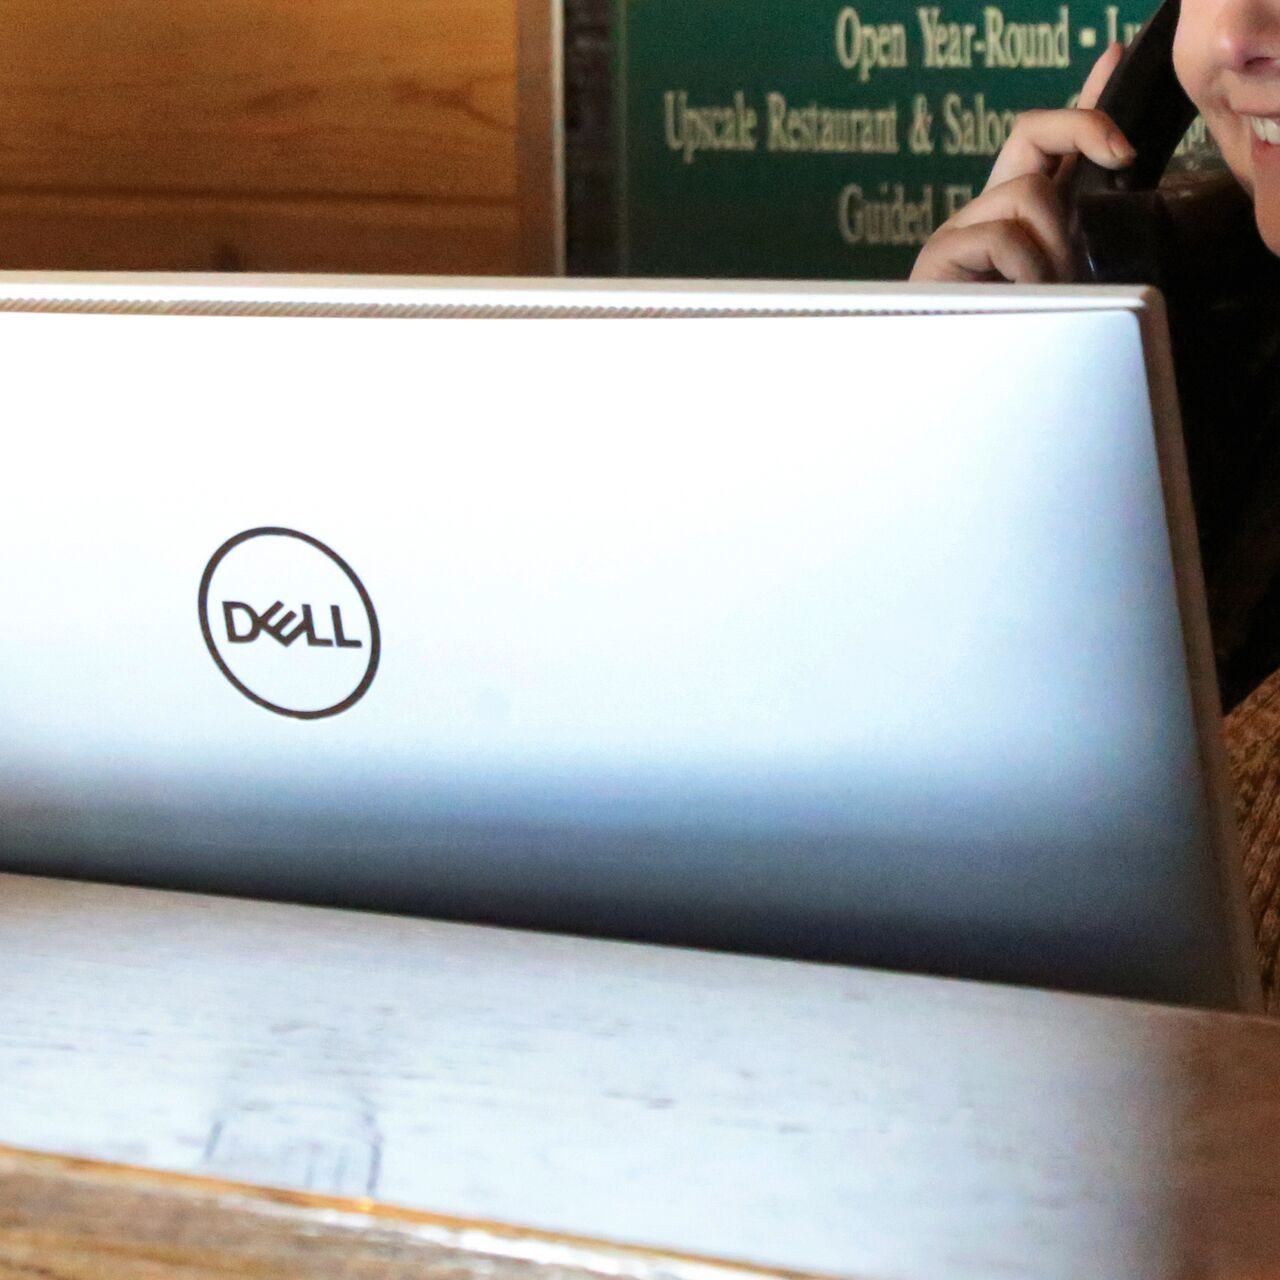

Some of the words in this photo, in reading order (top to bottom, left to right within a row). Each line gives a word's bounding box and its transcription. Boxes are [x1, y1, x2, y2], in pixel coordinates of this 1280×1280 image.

[836, 6, 908, 81] Open
[918, 5, 1070, 69] Year-Round
[664, 90, 757, 163] Upscale
[766, 92, 899, 155] Restaurant
[908, 93, 935, 155] &
[838, 183, 934, 246] Guided
[222, 600, 364, 649] DELL
